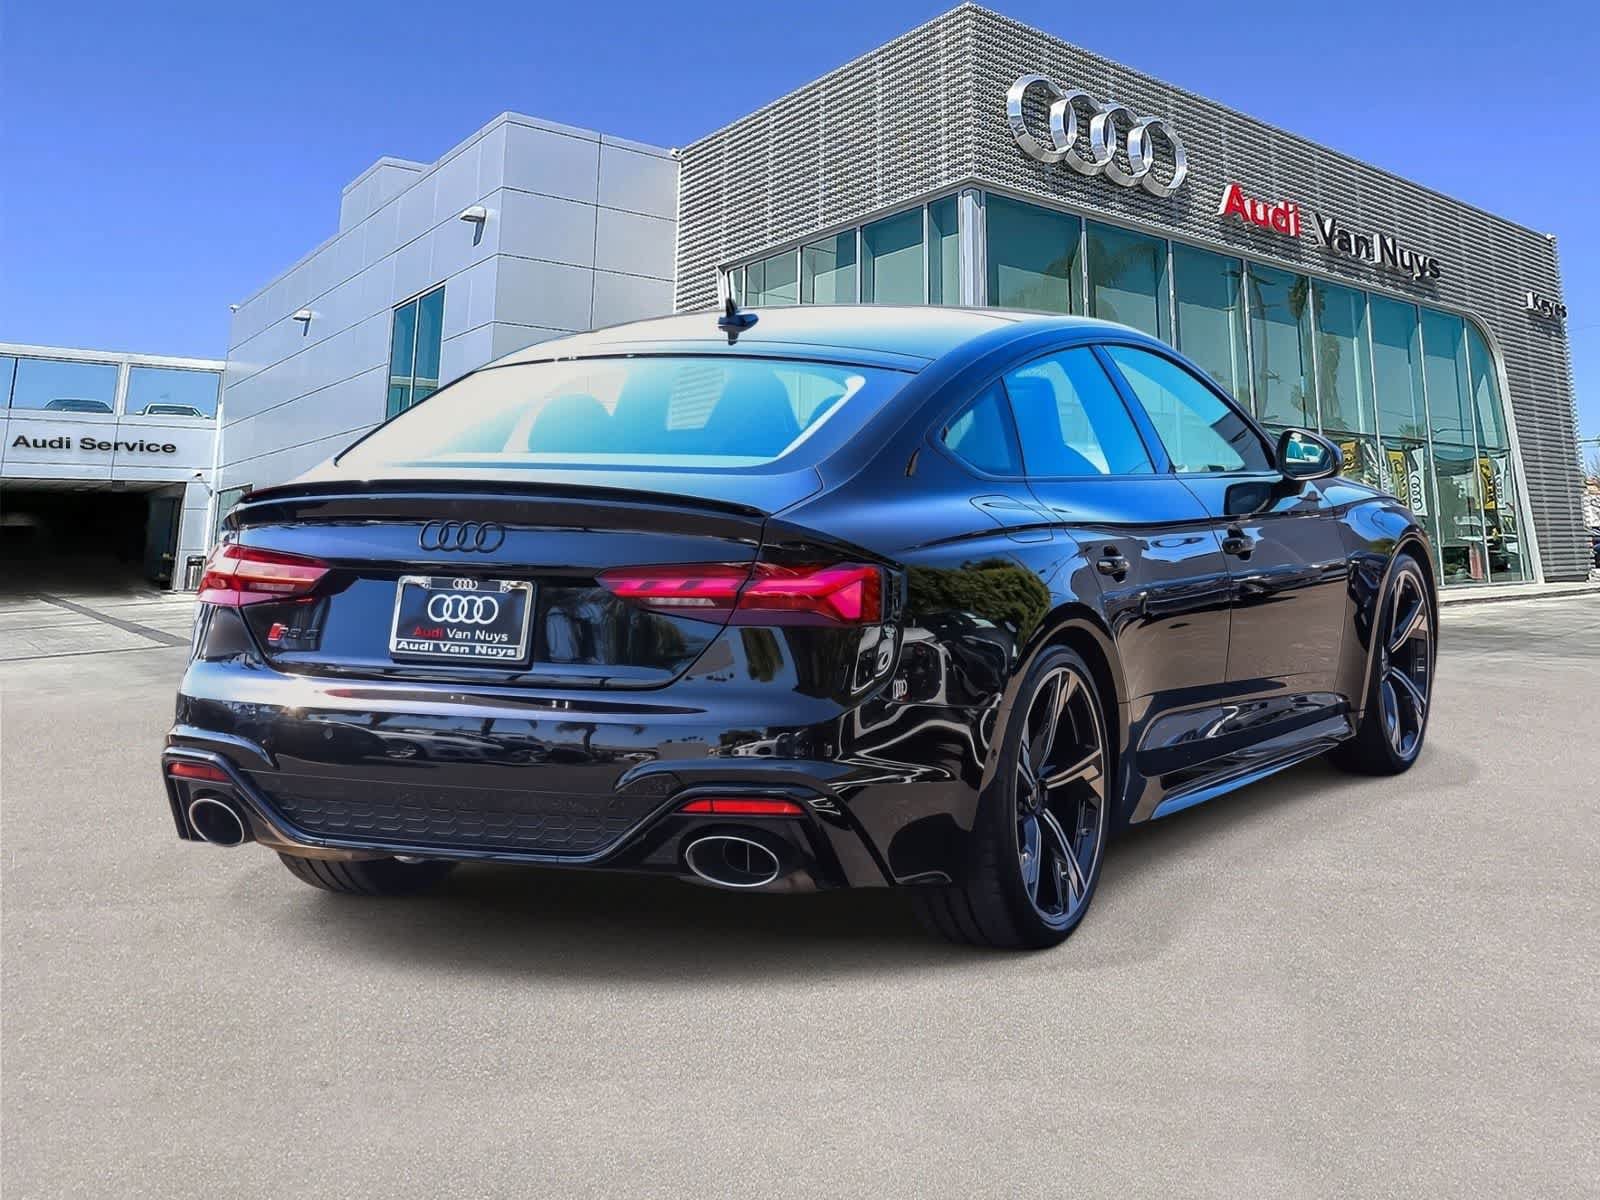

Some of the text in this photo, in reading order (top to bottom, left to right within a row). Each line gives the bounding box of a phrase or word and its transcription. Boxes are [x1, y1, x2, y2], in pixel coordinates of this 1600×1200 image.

[1218, 184, 1441, 280] Audi Van Nuys
[1526, 291, 1567, 317] Keyes
[12, 435, 177, 454] Audi Service
[413, 627, 508, 643] Audi Van Nuys
[397, 641, 516, 656] Audi Van Nuys
